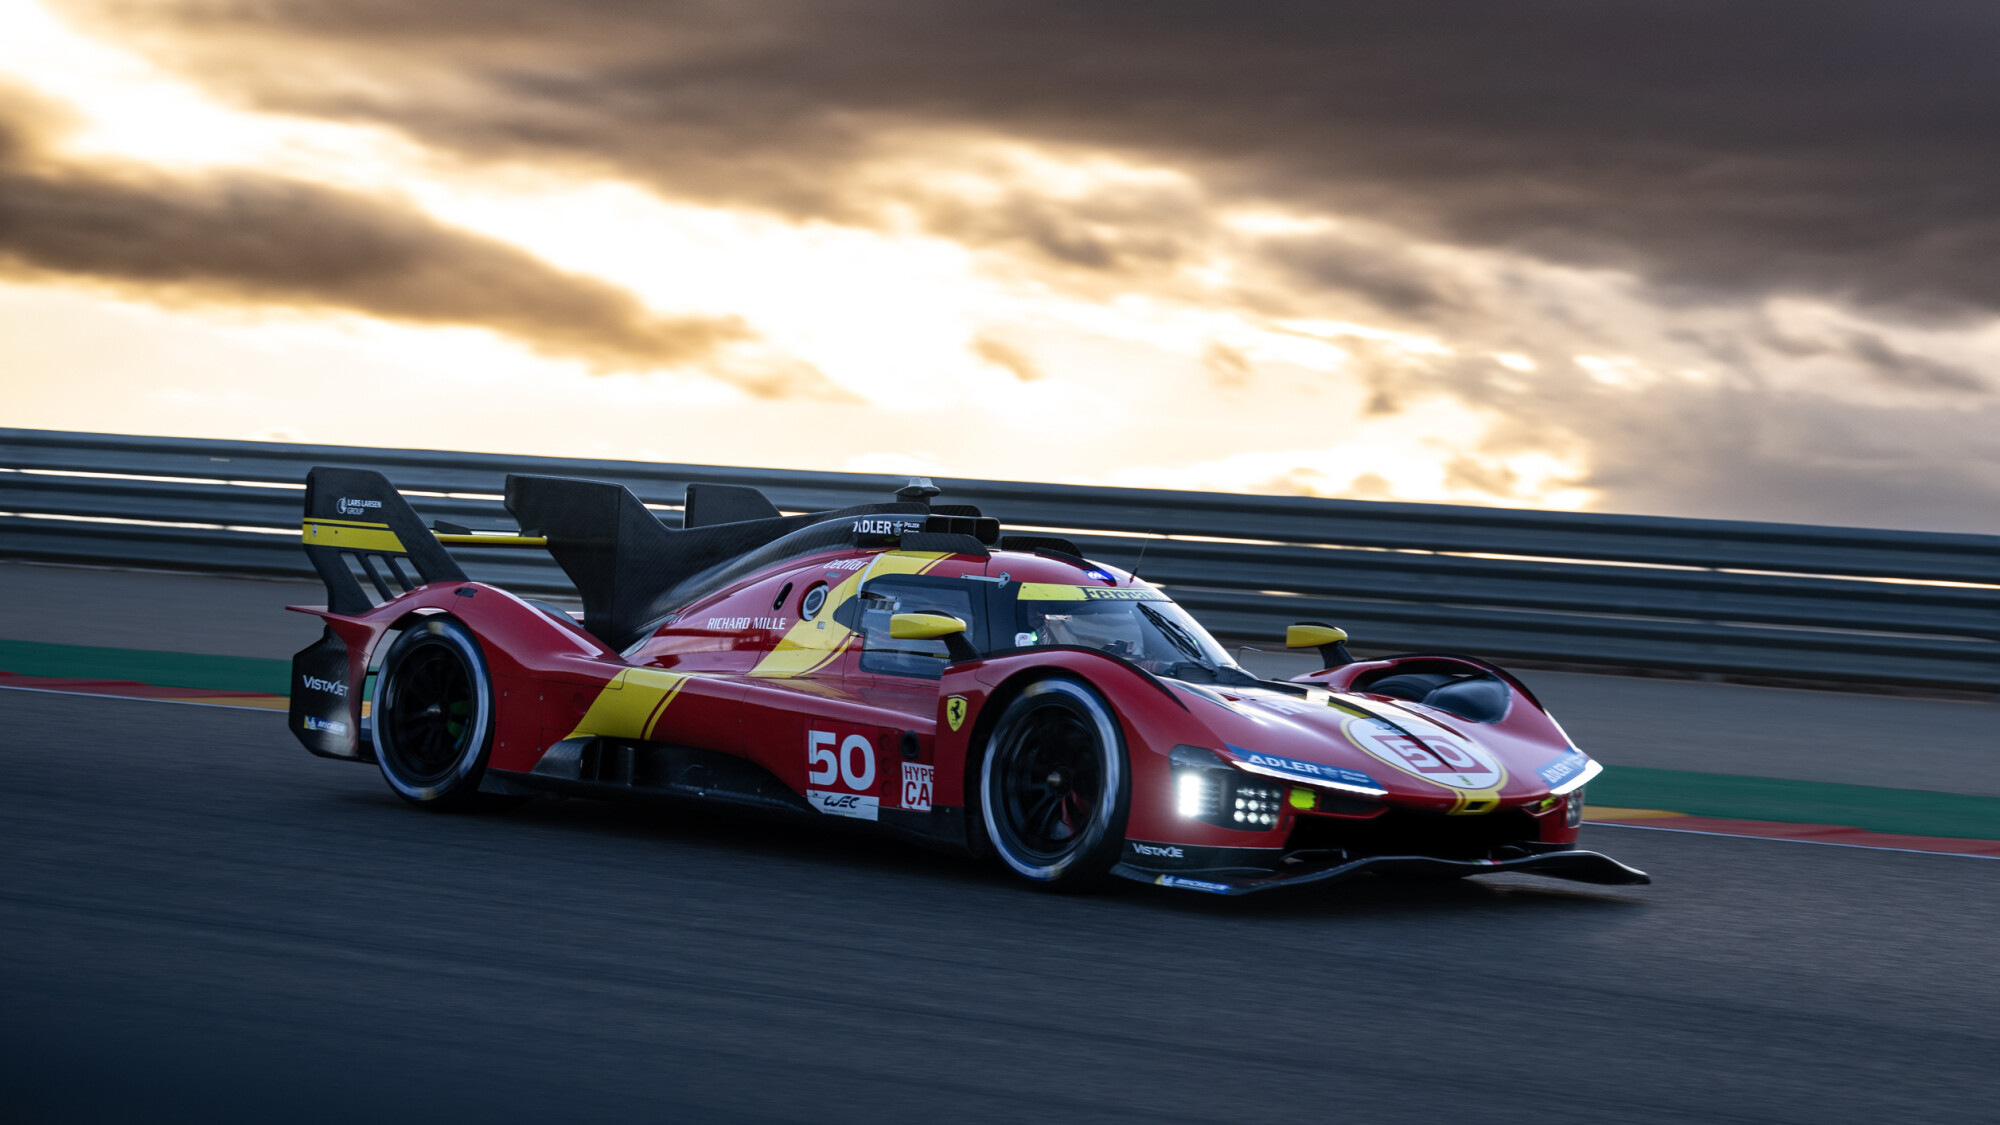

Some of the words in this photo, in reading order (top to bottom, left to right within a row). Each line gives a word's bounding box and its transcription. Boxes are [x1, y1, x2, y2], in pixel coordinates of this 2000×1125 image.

[346, 507, 364, 515] GROUP
[347, 499, 361, 507] LARS
[361, 500, 382, 508] LARSEN
[852, 520, 892, 535] ADLER
[706, 617, 750, 630] RICHARD
[752, 617, 787, 630] MILLE
[302, 674, 349, 698] VISTAJET
[808, 729, 876, 791] 50
[1382, 739, 1476, 769] 50
[1248, 754, 1322, 775] ADLER
[824, 795, 860, 809] WEC
[904, 781, 931, 808] CA
